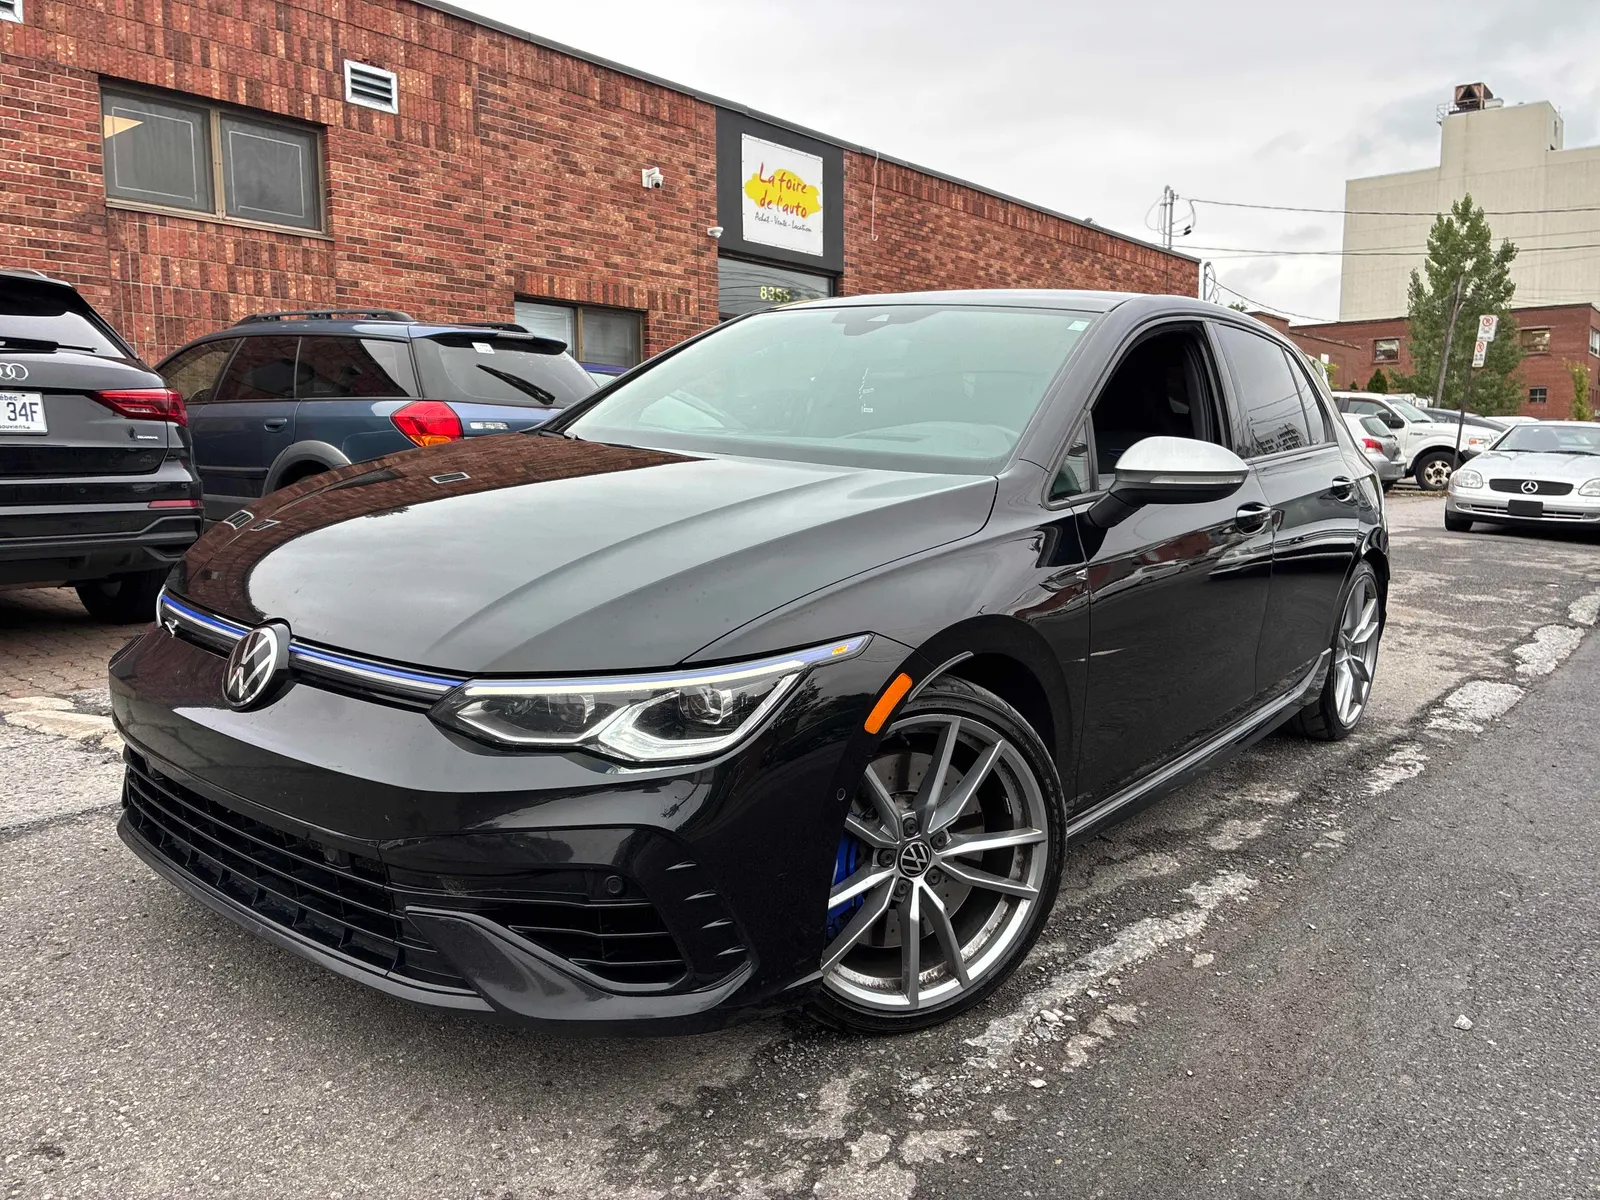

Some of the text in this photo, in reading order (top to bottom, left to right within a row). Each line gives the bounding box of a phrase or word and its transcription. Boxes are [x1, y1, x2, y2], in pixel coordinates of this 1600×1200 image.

[759, 162, 807, 194] La foire
[760, 190, 807, 218] de l'auto
[755, 212, 770, 224] Achat
[760, 286, 790, 302] 8355
[6, 402, 39, 422] 34F
